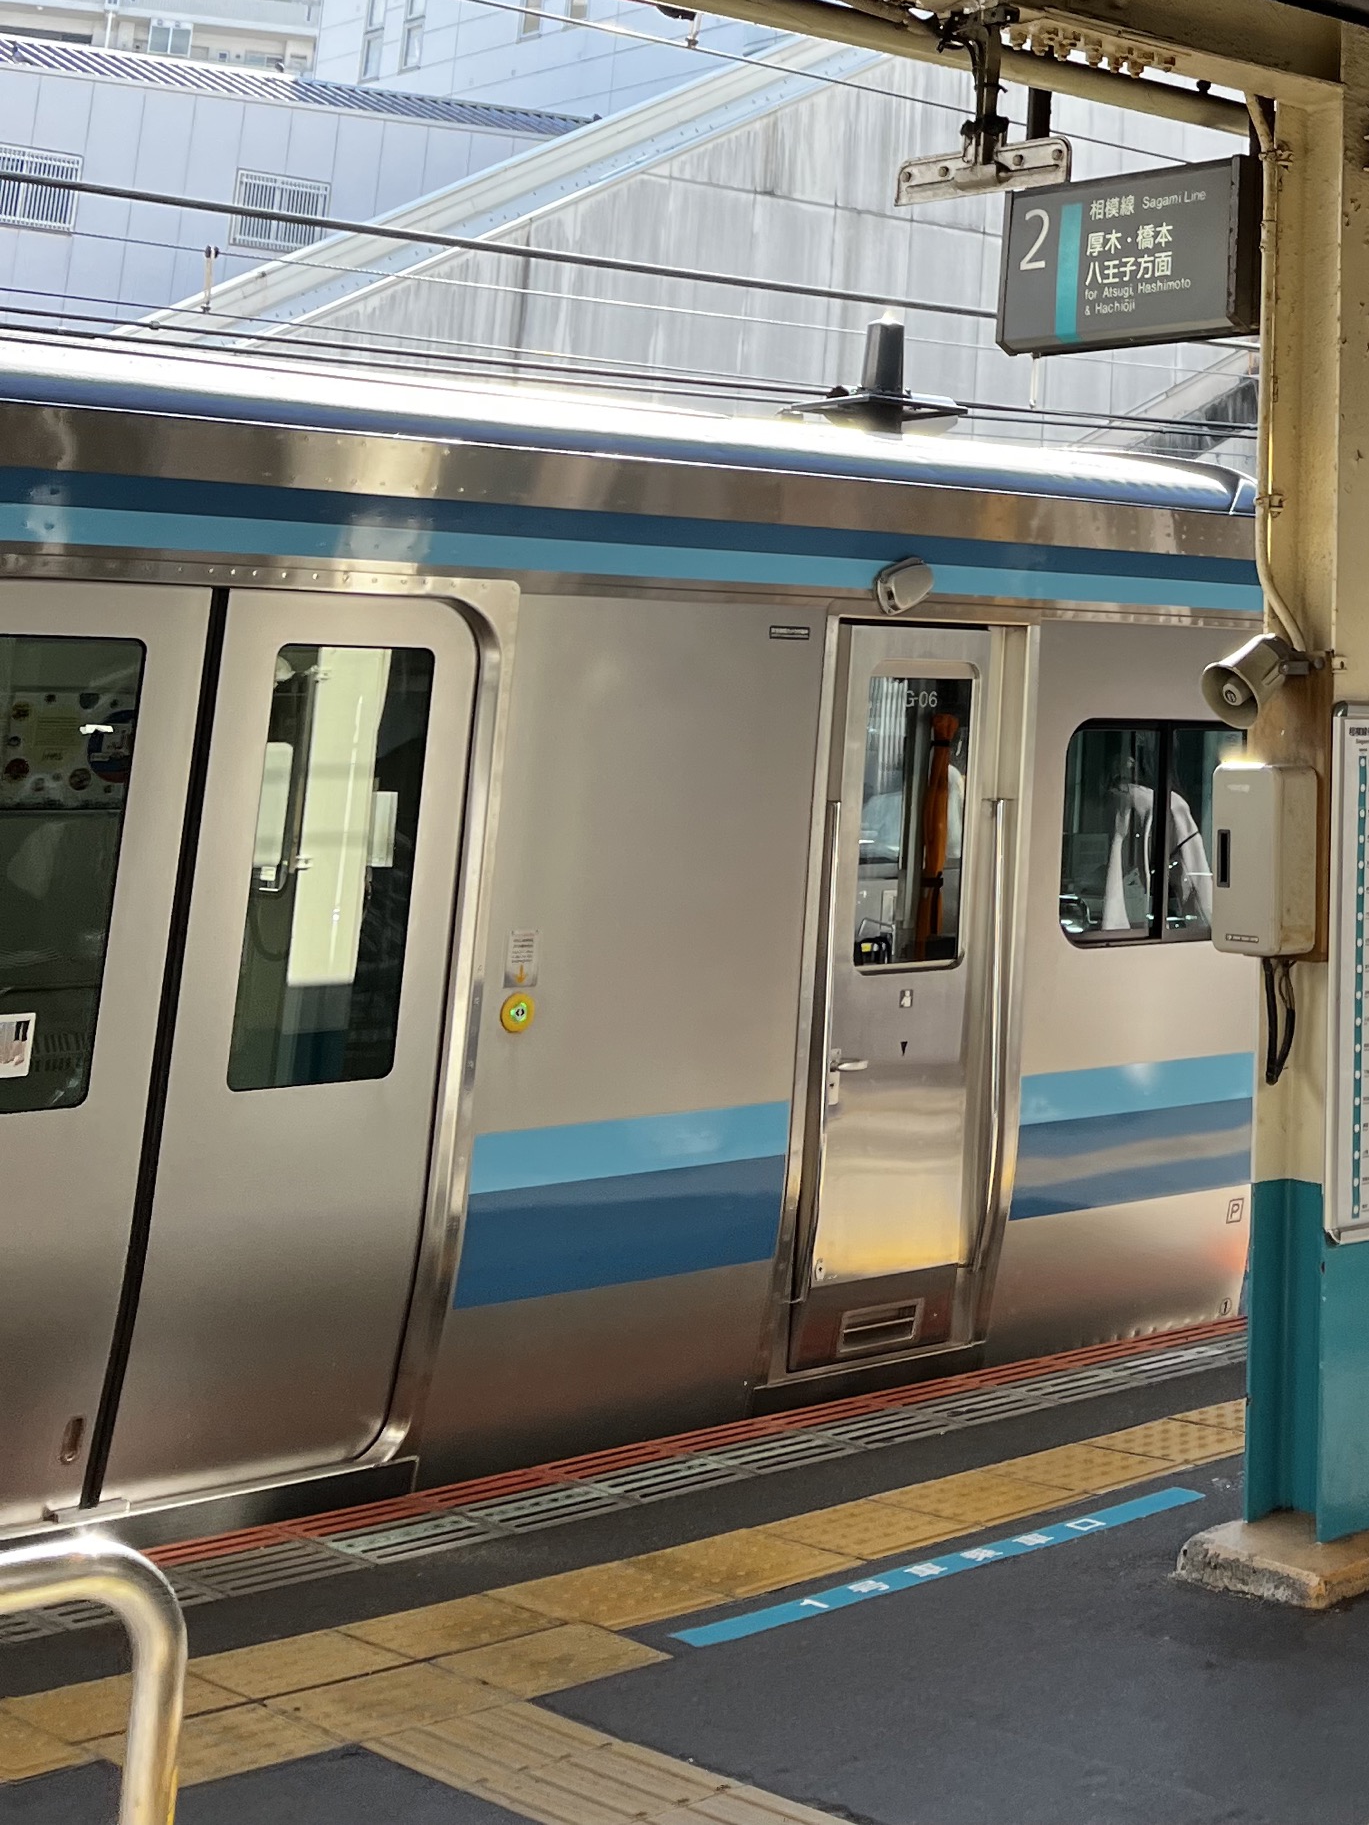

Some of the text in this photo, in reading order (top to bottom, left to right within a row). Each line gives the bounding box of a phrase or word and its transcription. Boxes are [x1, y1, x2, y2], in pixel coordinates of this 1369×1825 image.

[1090, 190, 1207, 220] 相模線 Sagami Line
[1019, 208, 1050, 271] 2
[1086, 221, 1173, 256] 厚木・橋本
[1085, 251, 1173, 286] 八王子方面
[1084, 278, 1191, 300] for Atsugi, Hashimoto
[1084, 298, 1136, 316] & Hachiōji
[905, 690, 938, 708] G-06
